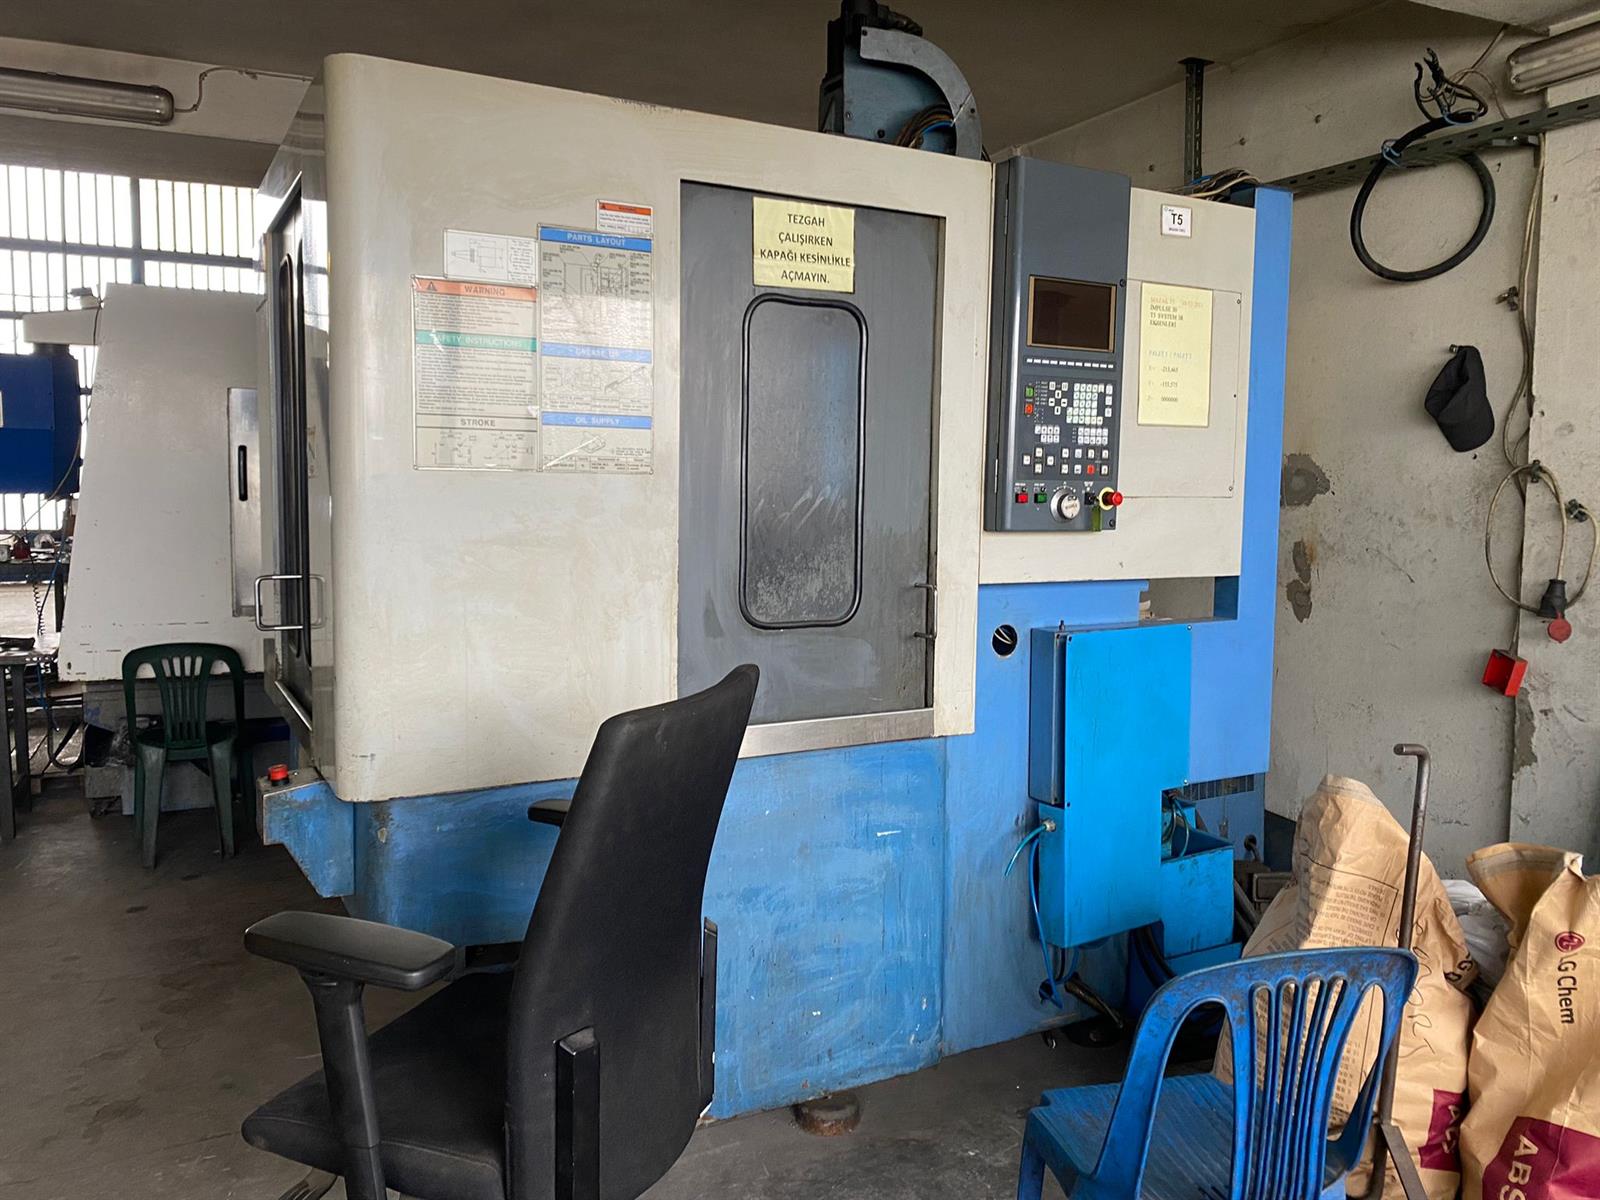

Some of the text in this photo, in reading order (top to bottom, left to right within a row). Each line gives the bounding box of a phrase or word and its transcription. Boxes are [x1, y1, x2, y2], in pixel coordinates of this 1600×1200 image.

[787, 213, 825, 227] TEZGAH
[1171, 212, 1183, 225] T5
[567, 232, 626, 247] PARTS LAYOUT
[778, 231, 833, 247] ÇALIŞIRKEN
[760, 249, 851, 267] KAPAĞI KESİNLİKLE
[780, 270, 830, 284] AÇMAYIN.
[464, 285, 506, 296] WARNING
[460, 418, 496, 428] STROKE
[1557, 975, 1578, 1025] Chem
